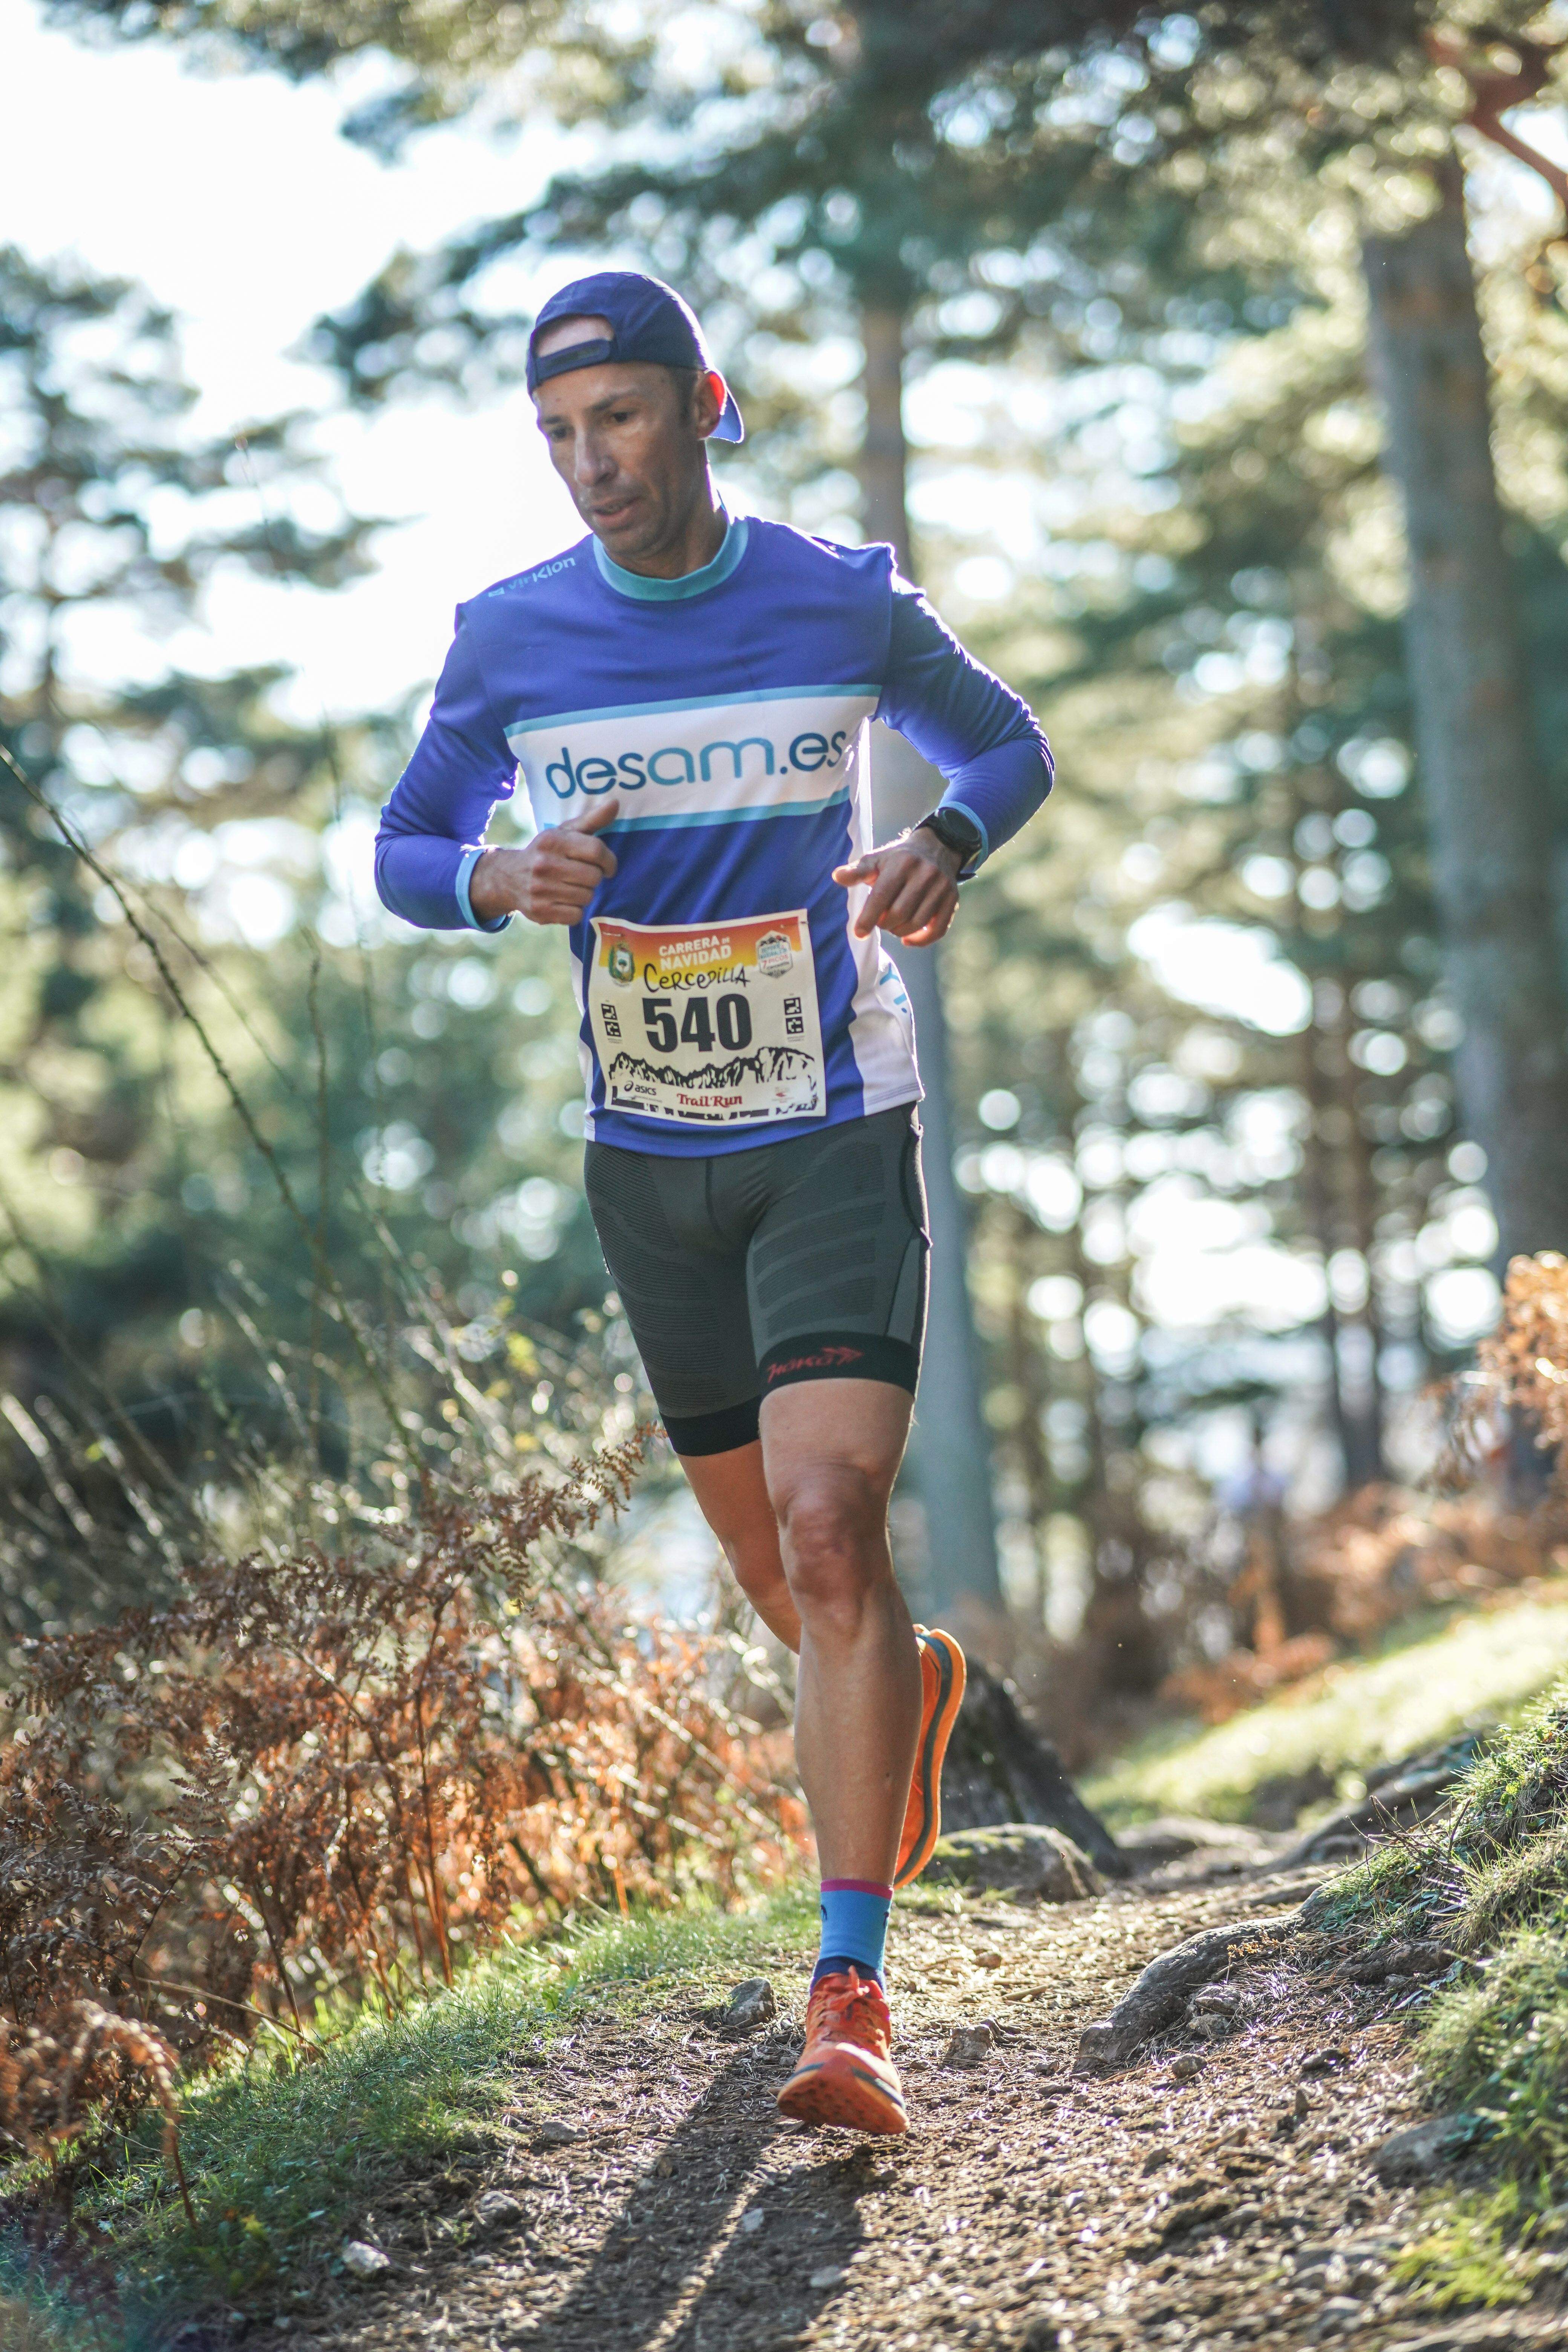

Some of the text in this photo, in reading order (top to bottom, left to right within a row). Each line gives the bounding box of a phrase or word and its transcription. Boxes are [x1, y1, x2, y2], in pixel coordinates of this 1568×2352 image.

[546, 730, 846, 799] desam.es
[659, 935, 719, 956] CARRERA
[660, 945, 732, 971] NAVIDAD
[642, 994, 752, 1053] 540
[635, 1084, 657, 1095] asics
[677, 1093, 708, 1107] Trail
[710, 1094, 743, 1109] Run
